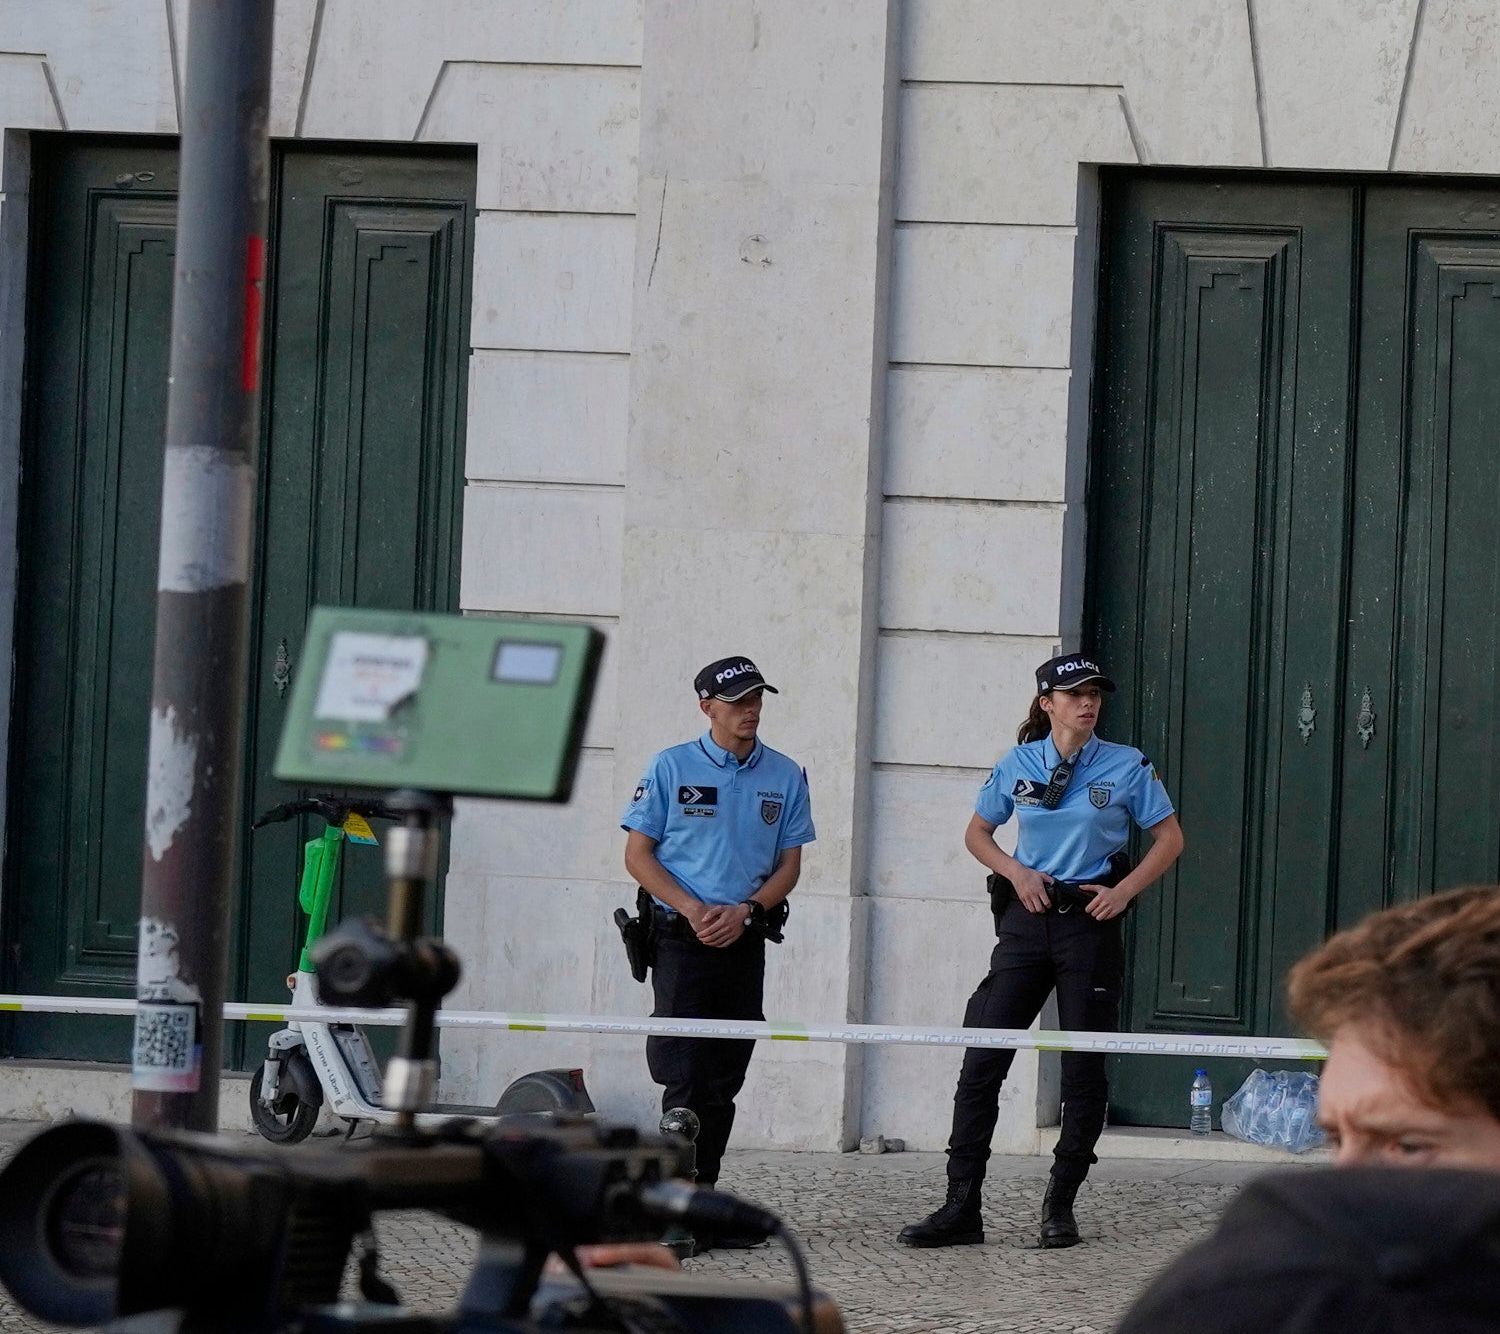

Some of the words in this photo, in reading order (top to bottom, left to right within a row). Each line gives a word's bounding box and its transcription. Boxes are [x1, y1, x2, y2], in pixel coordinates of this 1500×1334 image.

[757, 791, 784, 800] POLÍCIA
[314, 1043, 328, 1067] Lime
[329, 1073, 341, 1095] Uber
